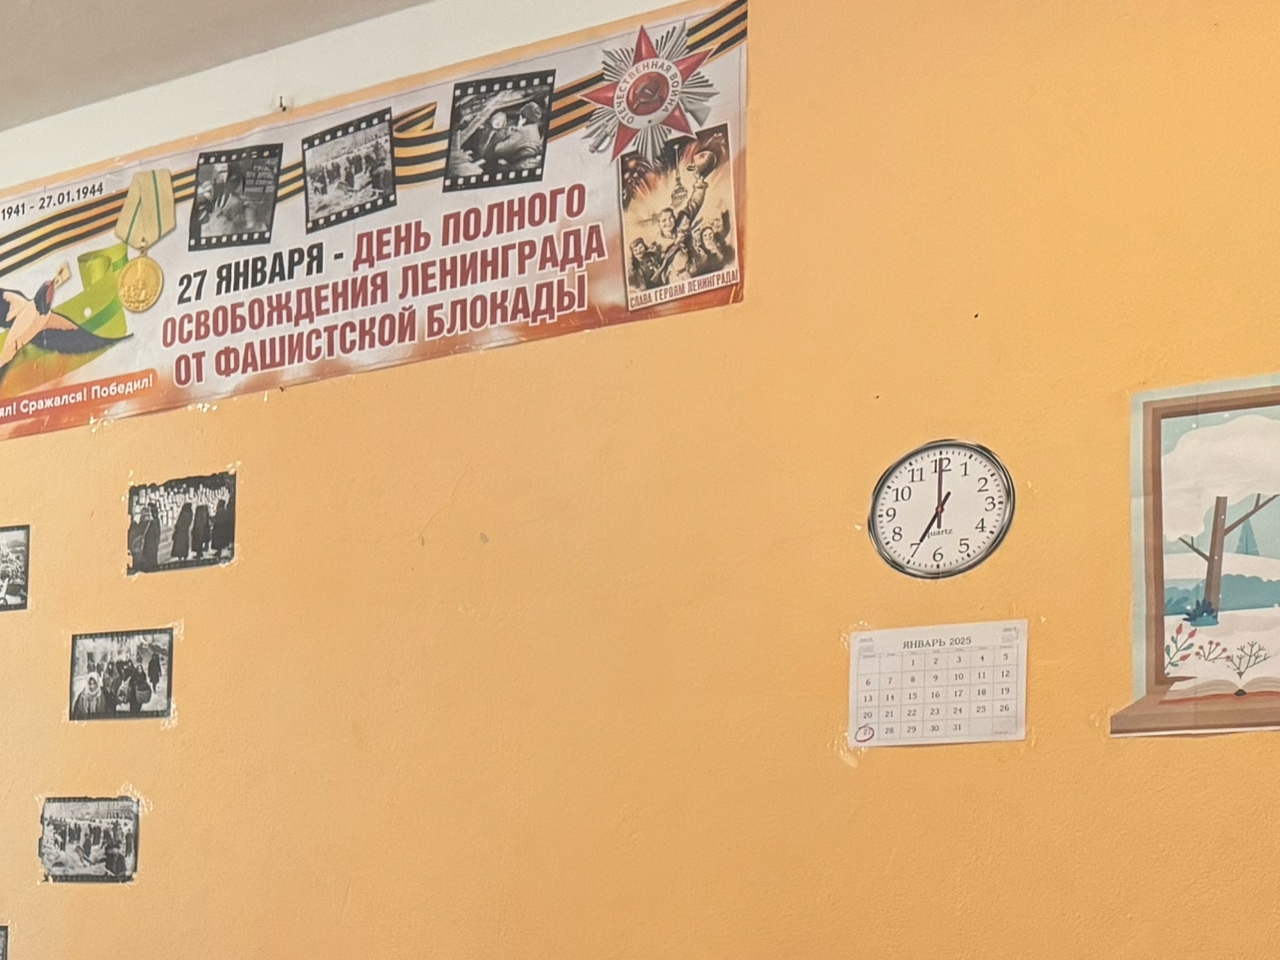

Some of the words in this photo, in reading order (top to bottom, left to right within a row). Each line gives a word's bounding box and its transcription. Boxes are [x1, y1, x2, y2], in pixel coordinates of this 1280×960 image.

[616, 61, 672, 124] ОТЕЧЕСТВЕННАЯ
[38, 182, 103, 210] 27.01.1944
[177, 269, 207, 305] 27
[215, 242, 324, 296] ЯНВАРЯ
[352, 220, 431, 272] ДЕНЬ
[441, 183, 586, 247] ПОЛНОГО
[162, 270, 388, 348] ОСВОБОЖДЕНИЯ
[398, 224, 606, 300] ЛЕНИНГРАДА
[630, 294, 653, 308] СЛАВА
[654, 283, 685, 301] ГЕРОЯМ
[175, 351, 206, 386] ОТ
[214, 304, 416, 377] ФАШИСТСКОЙ
[426, 274, 586, 338] БЛОКАДЫ
[20, 388, 87, 414] Сражался!
[91, 374, 153, 398] Победил!
[930, 457, 952, 474] 12
[960, 462, 970, 477] 1
[907, 467, 926, 483] 11
[977, 477, 989, 493] 2
[892, 485, 912, 503] 10
[985, 496, 996, 512] 3
[885, 507, 897, 523] 9
[974, 518, 987, 532] 4
[891, 526, 903, 542] 8
[910, 542, 921, 558] 7
[958, 538, 970, 553] 5
[932, 546, 944, 563] 6
[903, 638, 946, 649] ЯНВАРЬ
[949, 636, 972, 646] 2025
[978, 671, 986, 679] 11
[1001, 670, 1010, 678] 12
[908, 692, 917, 700] 15
[931, 691, 940, 699] 16
[954, 689, 963, 697] 17
[1001, 687, 1010, 695] 19
[863, 711, 873, 719] 20
[885, 710, 893, 718] 21
[976, 705, 986, 713] 25
[1000, 704, 1009, 712] 26
